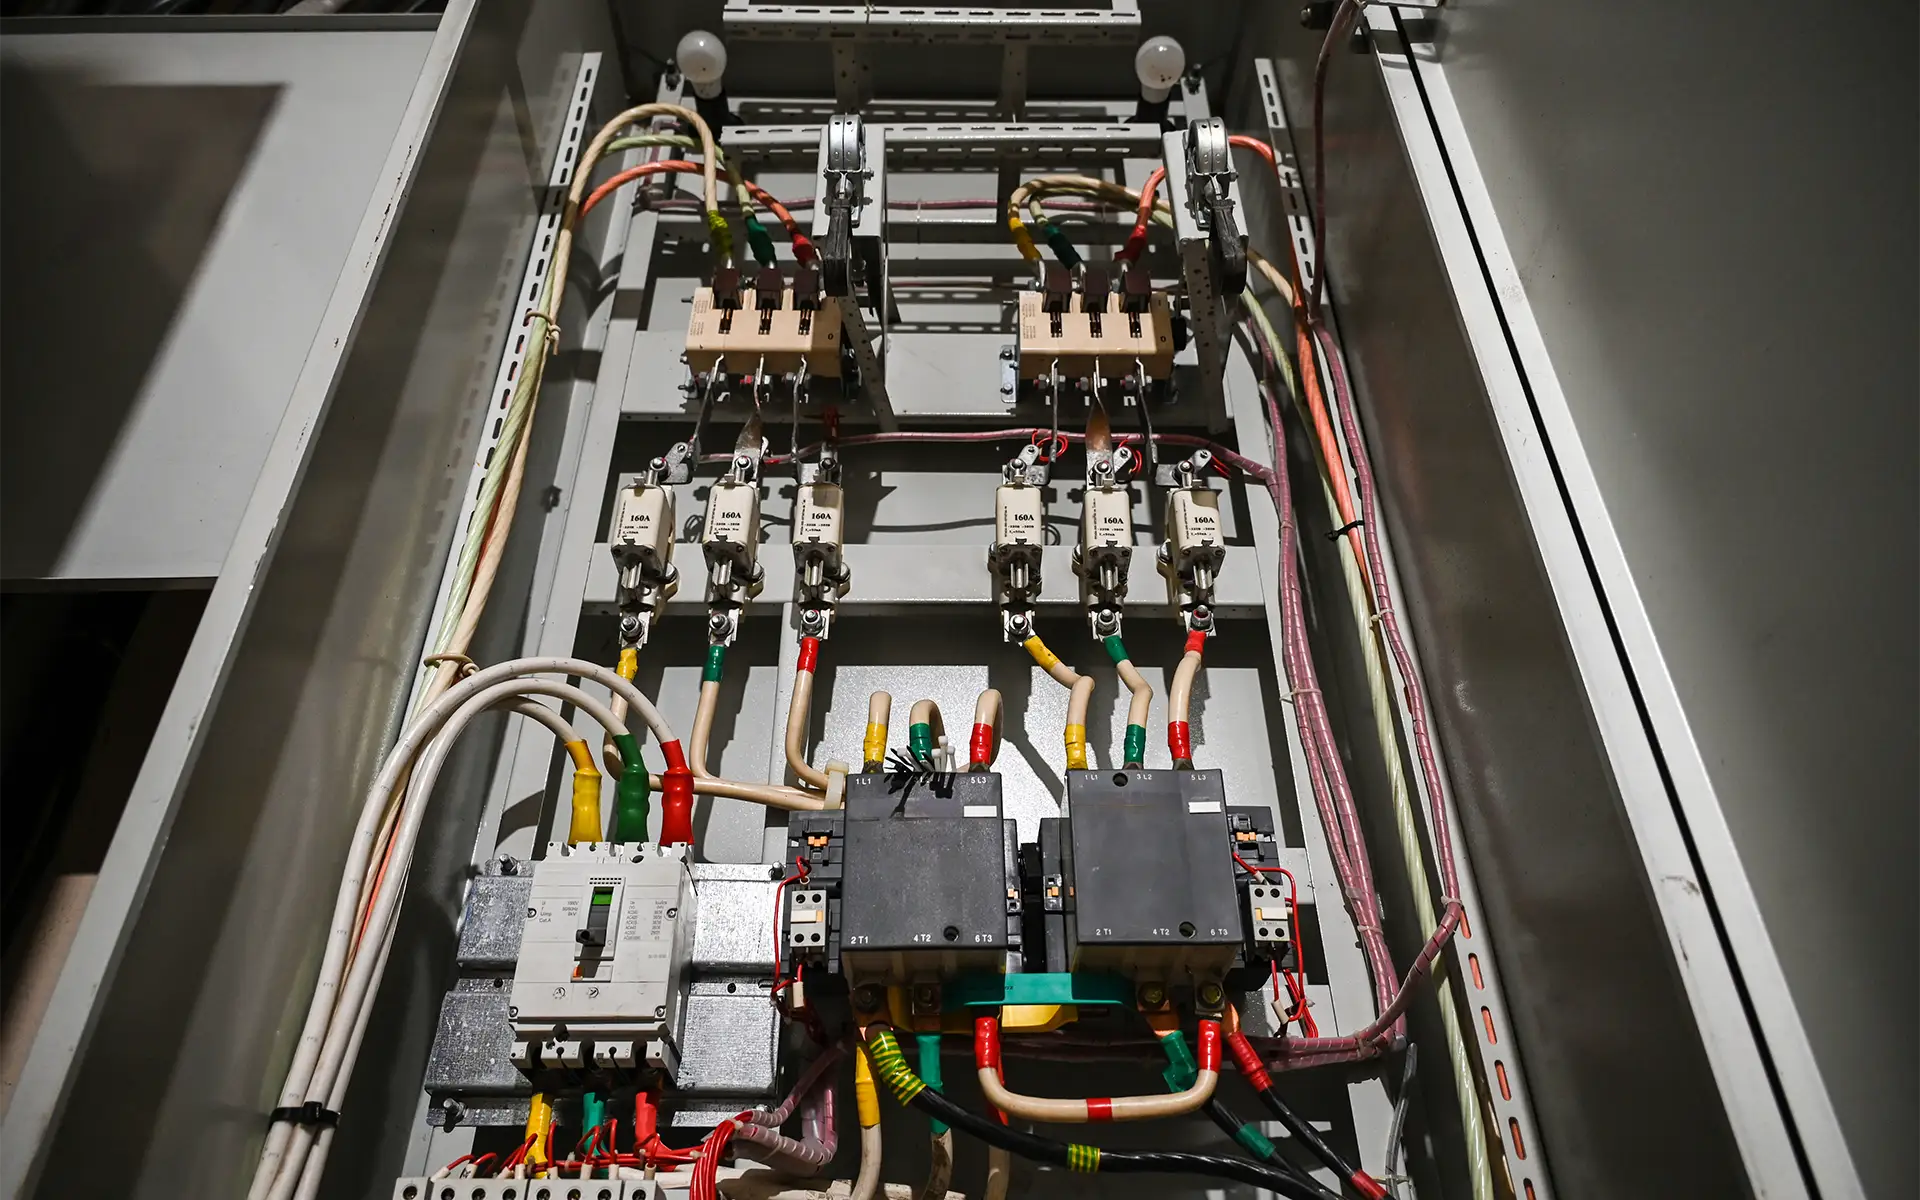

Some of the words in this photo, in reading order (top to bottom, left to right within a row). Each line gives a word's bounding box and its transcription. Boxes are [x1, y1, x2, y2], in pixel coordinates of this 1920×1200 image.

[630, 514, 651, 522] 160A
[721, 511, 741, 519] 160A
[811, 512, 832, 520] 160A
[1194, 516, 1215, 524] 160A
